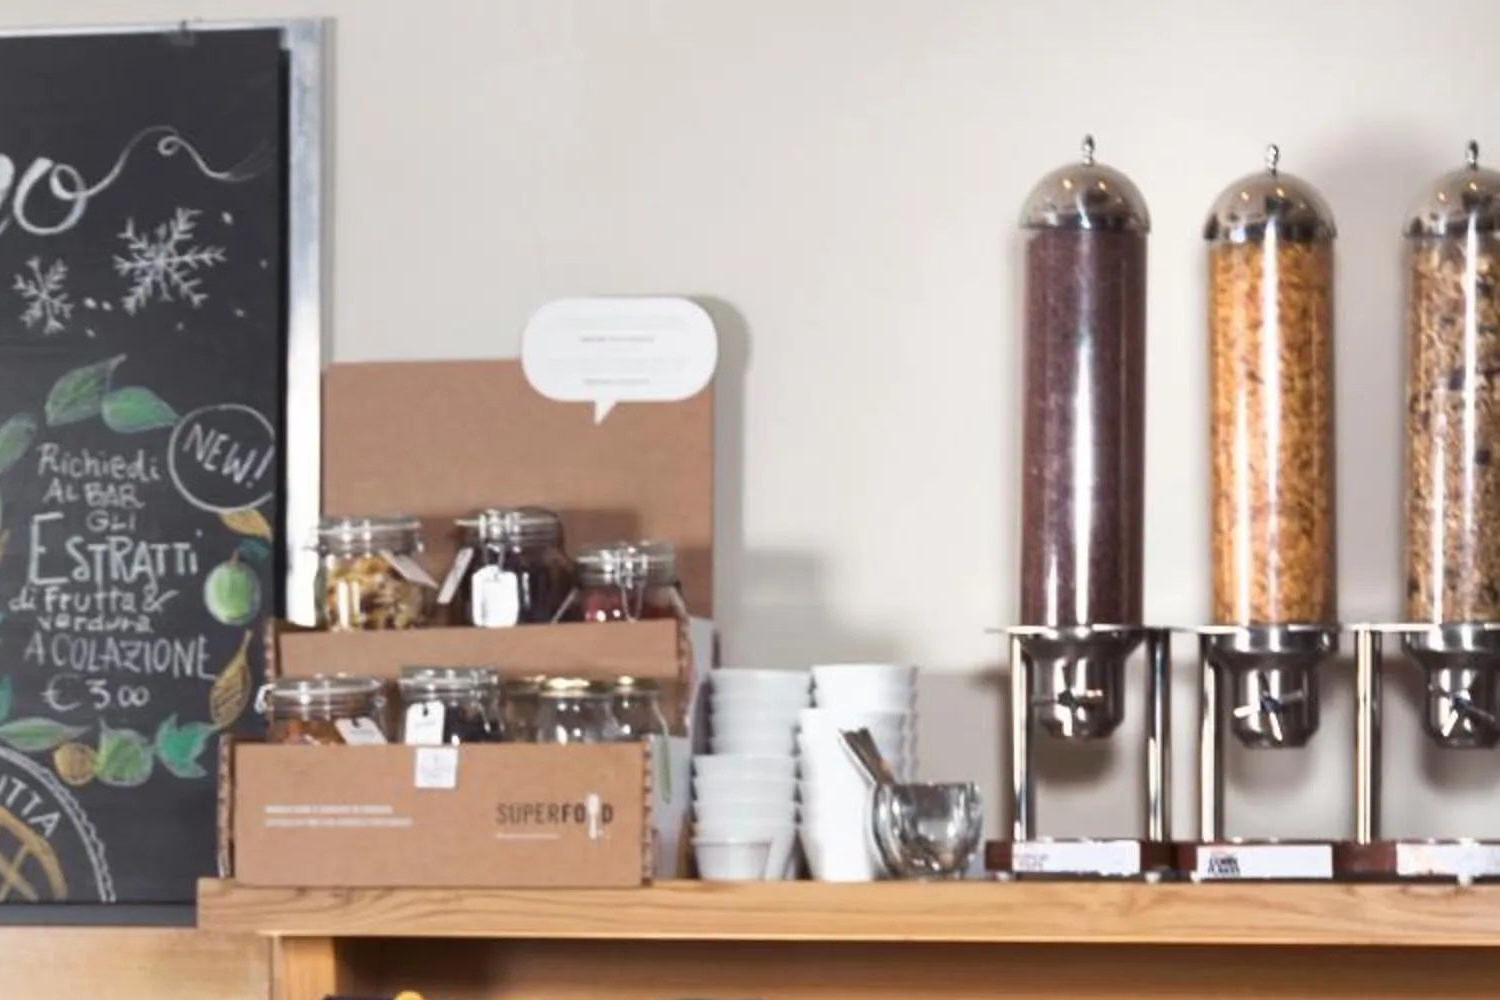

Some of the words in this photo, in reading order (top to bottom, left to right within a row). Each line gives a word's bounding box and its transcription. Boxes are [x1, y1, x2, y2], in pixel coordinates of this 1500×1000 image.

[36, 442, 160, 483] Richiedi
[183, 422, 276, 489] NEW!
[83, 482, 146, 509] BAR
[86, 510, 137, 533] GLI
[8, 585, 37, 612] di
[23, 631, 46, 666] A
[51, 632, 217, 681] COLAZIONE
[496, 802, 614, 825] SUPERFOD
